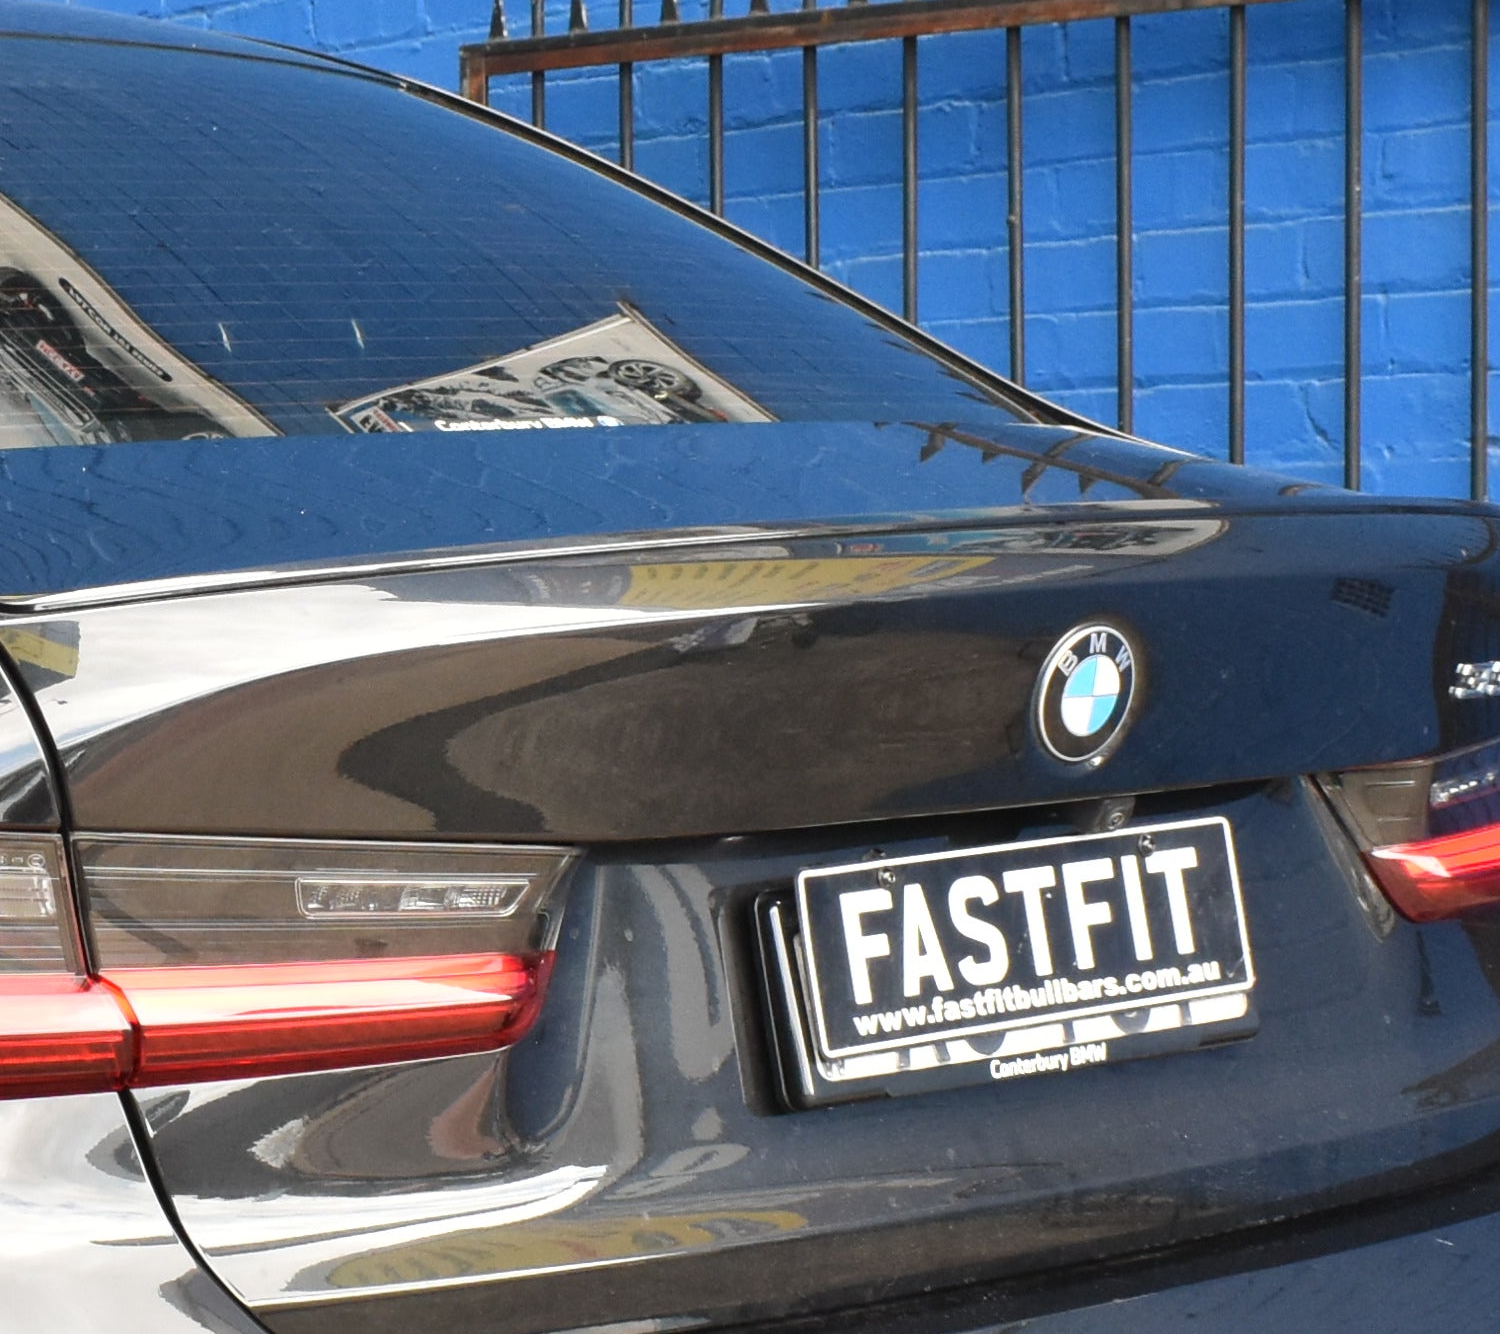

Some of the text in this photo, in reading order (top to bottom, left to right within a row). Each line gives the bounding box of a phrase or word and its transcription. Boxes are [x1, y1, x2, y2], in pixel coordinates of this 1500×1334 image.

[1057, 632, 1131, 677] BMW
[838, 845, 1199, 1006] FASTFIT
[853, 959, 1221, 1037] www.fastfitbullbars.com.au
[989, 1041, 1107, 1080] Canterbury BMW
